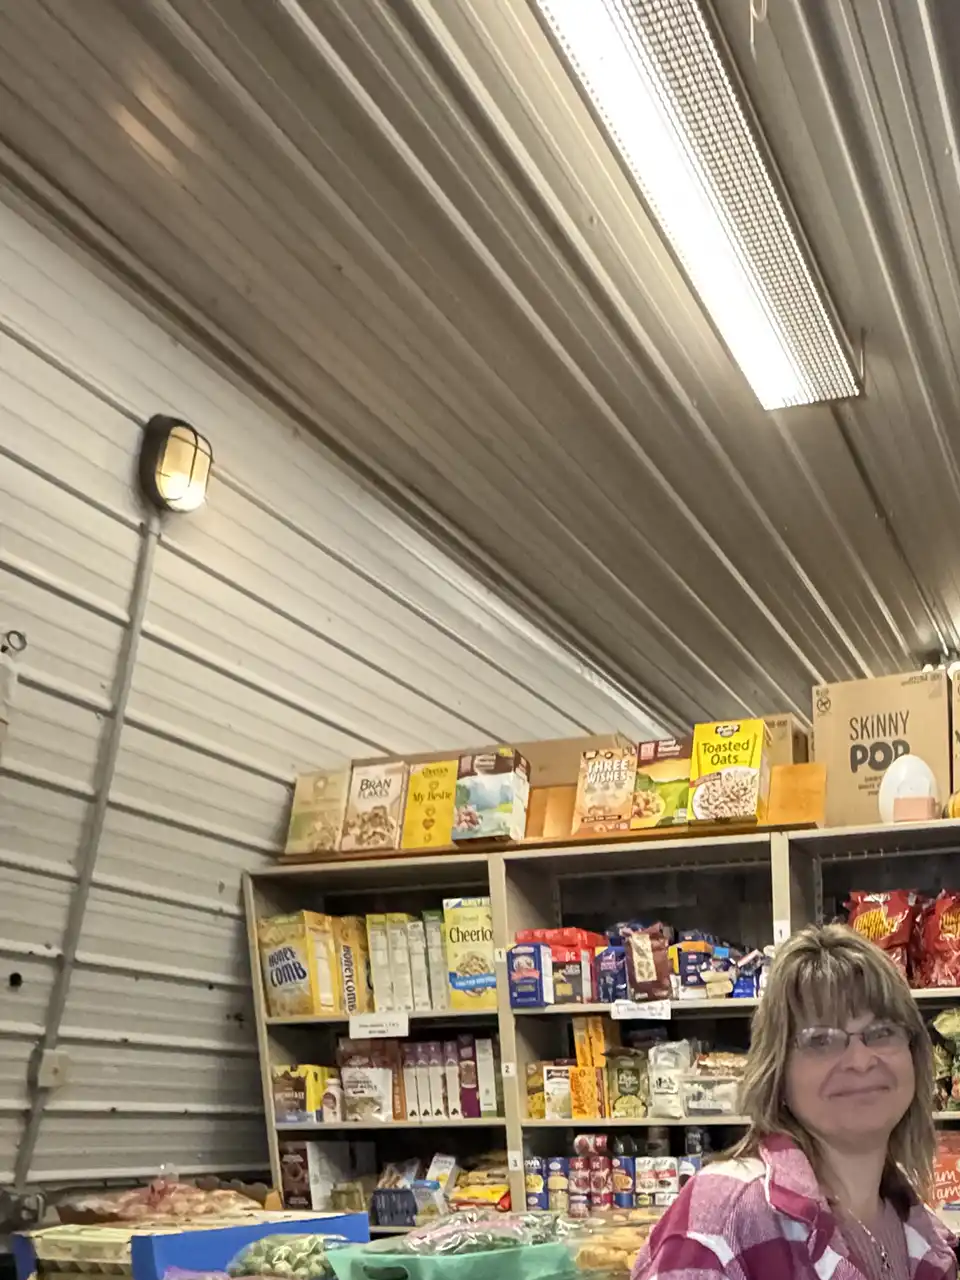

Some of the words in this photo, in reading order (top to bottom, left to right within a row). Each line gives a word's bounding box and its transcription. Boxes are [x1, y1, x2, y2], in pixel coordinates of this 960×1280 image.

[701, 739, 749, 754] Toasted
[710, 753, 738, 766] Oats
[850, 739, 910, 773] POP
[588, 759, 629, 773] THREE
[588, 771, 628, 784] WISHES
[360, 778, 392, 791] BRAN
[358, 787, 390, 799] FLAKES
[270, 962, 307, 988] COMB
